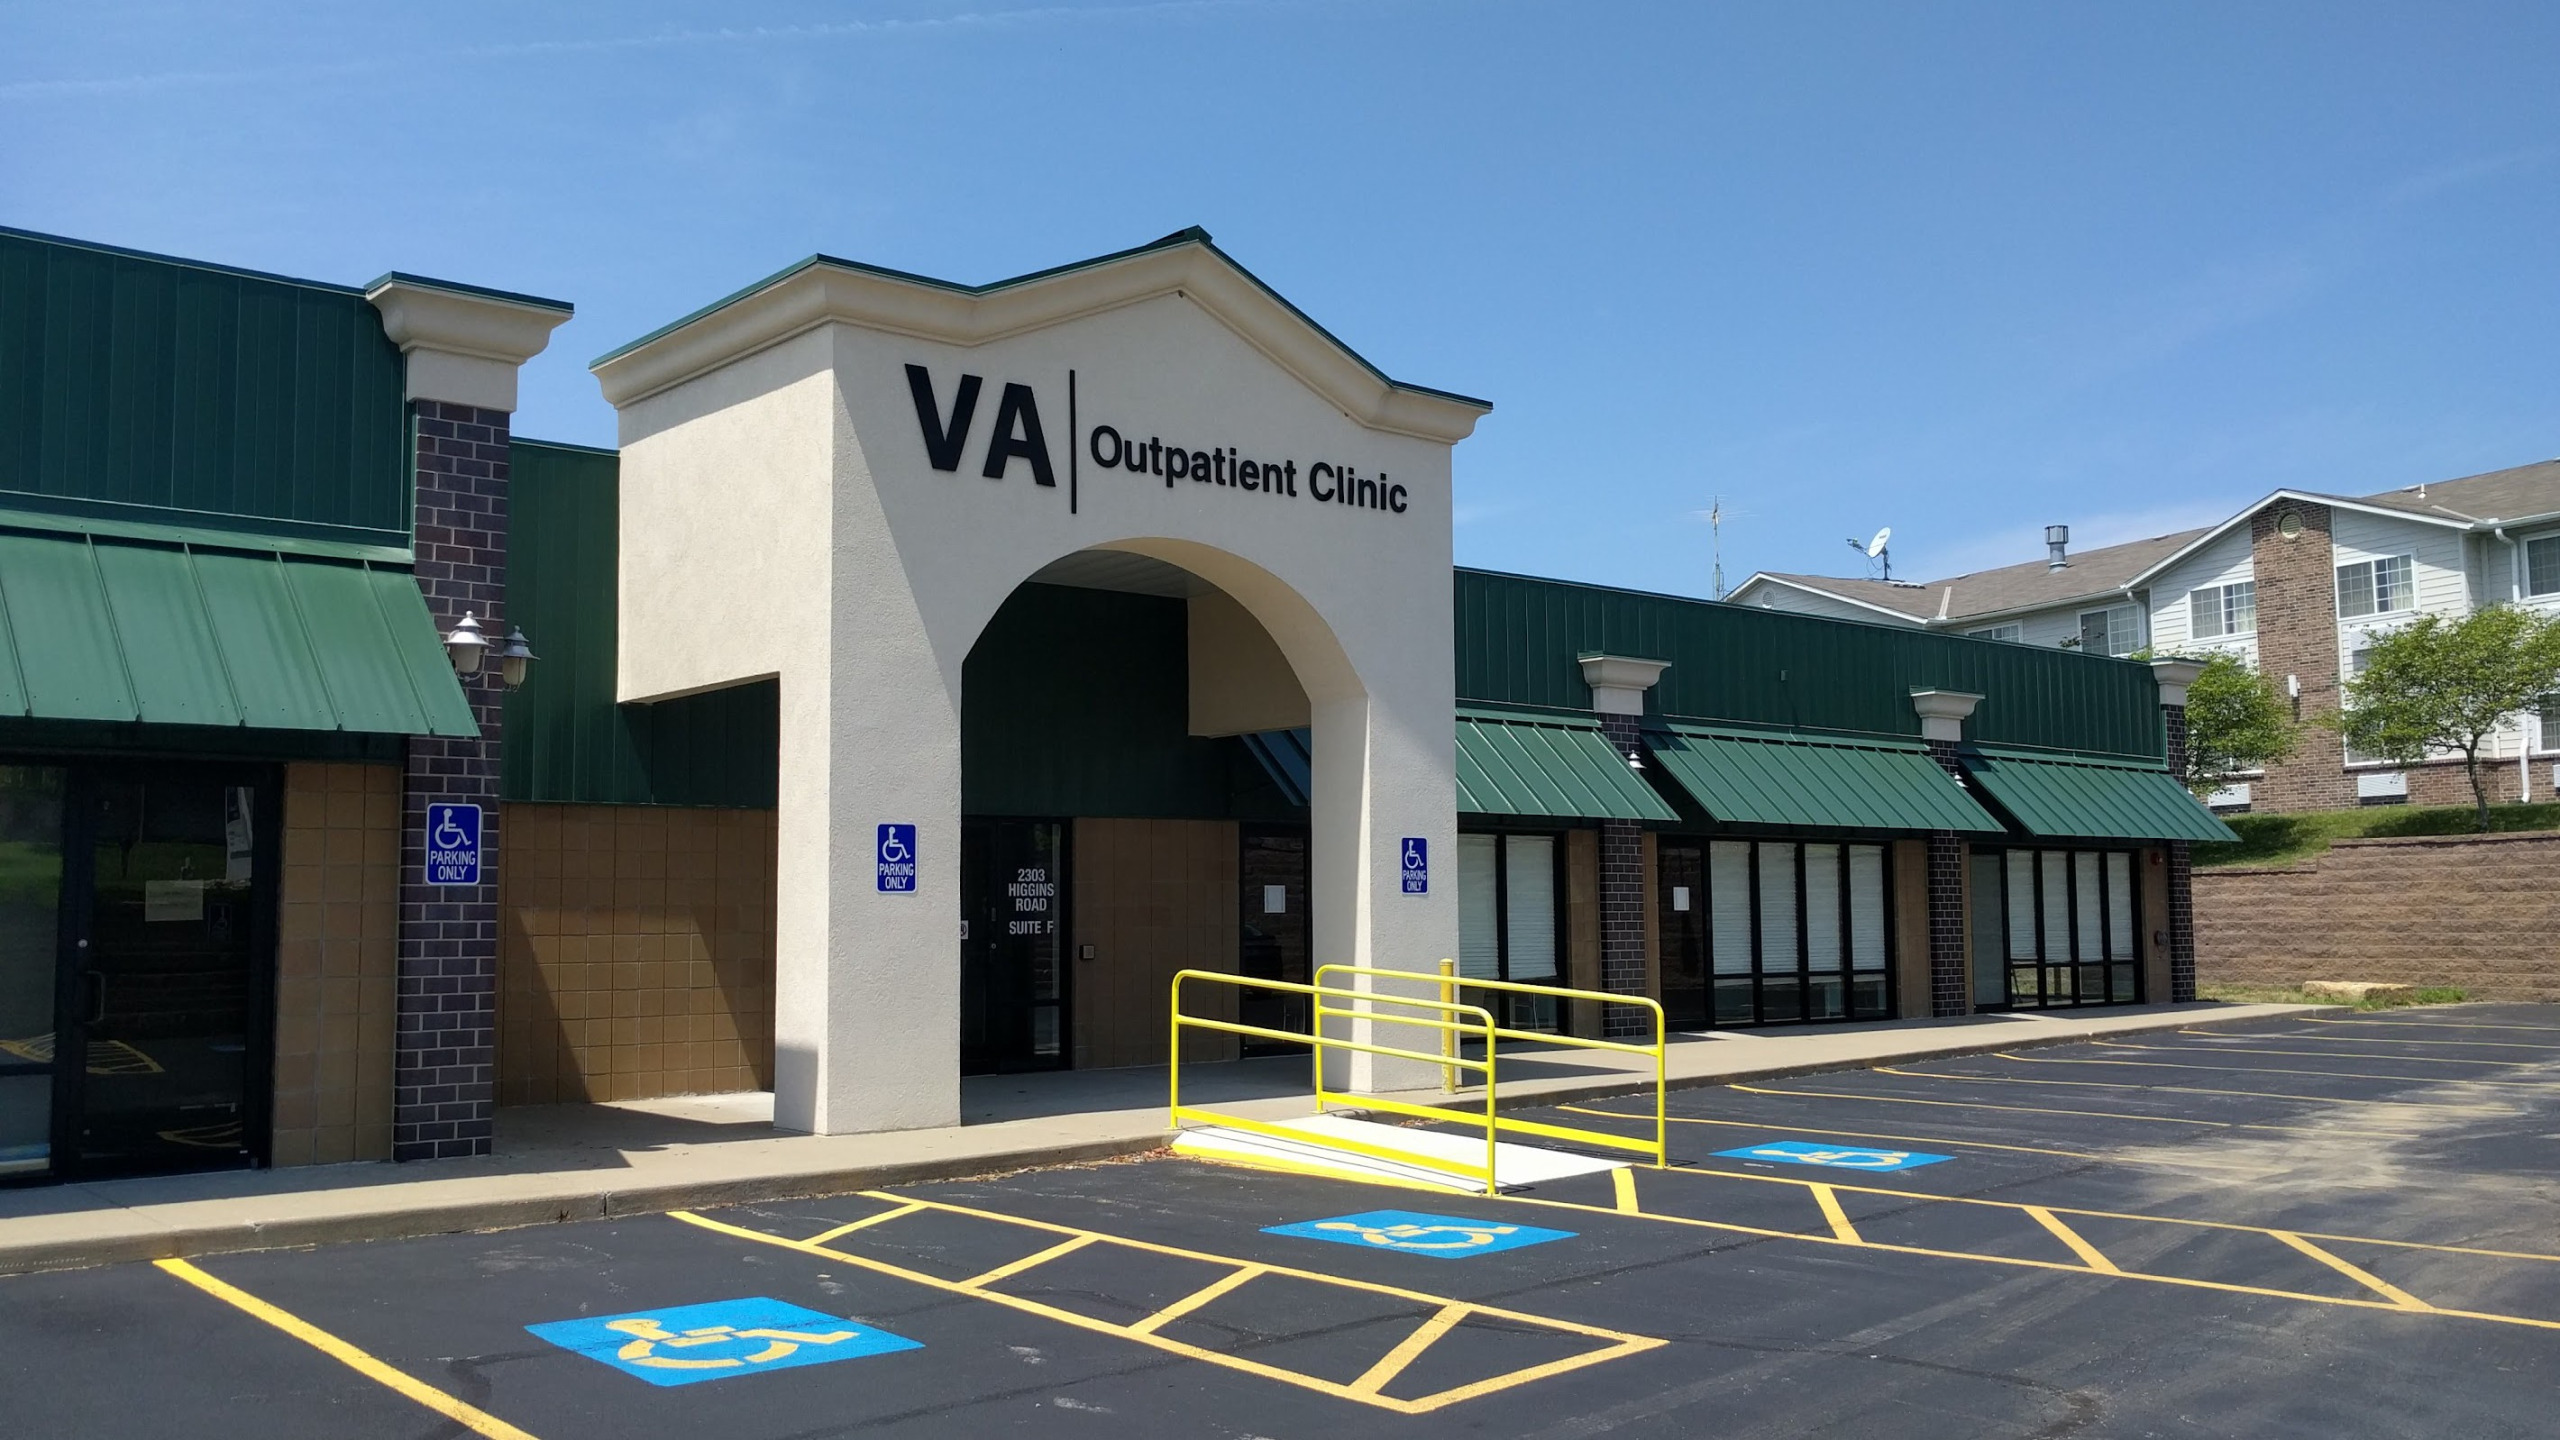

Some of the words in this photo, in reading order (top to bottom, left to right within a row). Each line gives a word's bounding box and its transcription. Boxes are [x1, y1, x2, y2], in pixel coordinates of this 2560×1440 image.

[904, 363, 1056, 488] VA
[1090, 425, 1297, 498] Outpatient
[1309, 461, 1408, 514] Clinic
[430, 850, 476, 866] PARKING
[437, 865, 468, 881] ONLY
[879, 862, 914, 876] PARKING
[1017, 868, 1046, 882] 2303
[1403, 869, 1427, 881] PARKING
[885, 876, 908, 889] ONLY
[1008, 882, 1055, 897] HIGGINS
[1407, 880, 1423, 891] ONLY
[1015, 897, 1047, 912] ROAD
[1009, 920, 1042, 935] SUITE
[1046, 920, 1054, 934] F
